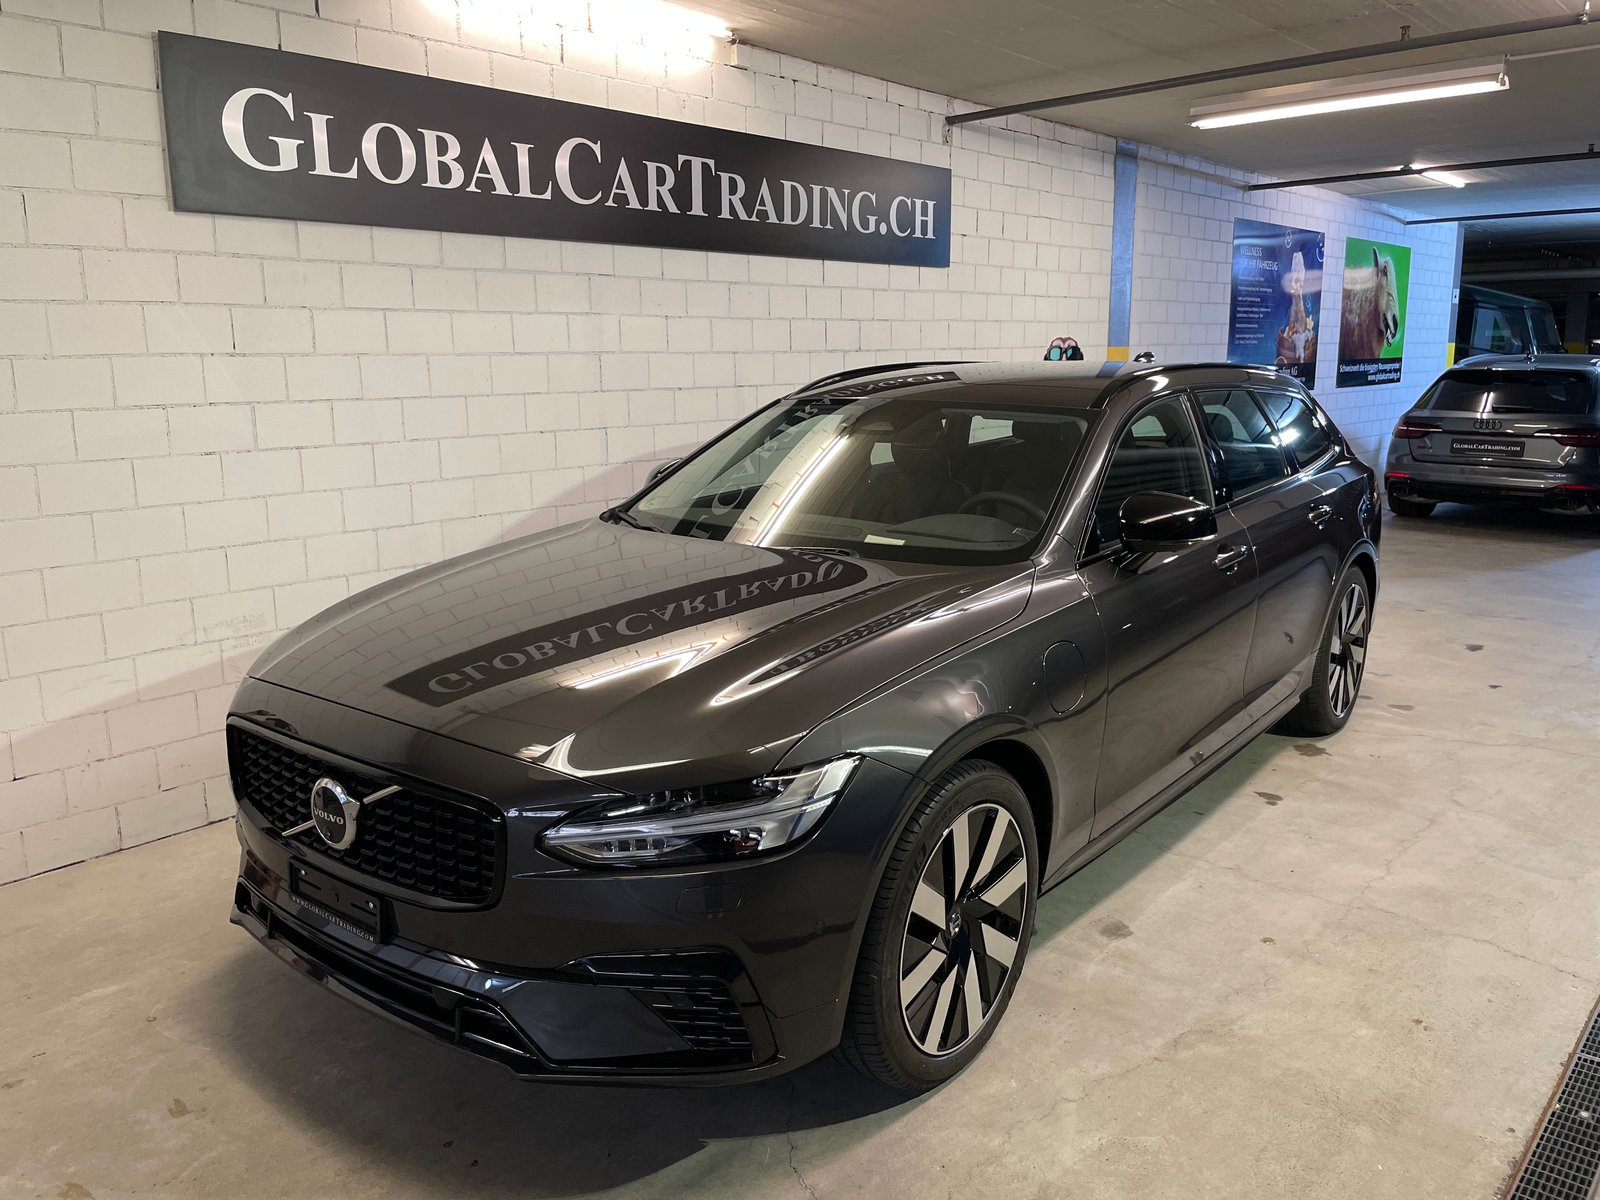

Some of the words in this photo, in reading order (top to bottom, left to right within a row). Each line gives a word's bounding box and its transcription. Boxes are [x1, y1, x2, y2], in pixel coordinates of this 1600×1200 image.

[221, 87, 937, 240] GLOBALCARTRADING.CH
[1239, 245, 1263, 257] WELLNESS
[1256, 259, 1279, 271] FAHRZEUG
[1453, 442, 1521, 451] GLOBALCARTRADING.COM
[313, 806, 344, 825] VOLVO
